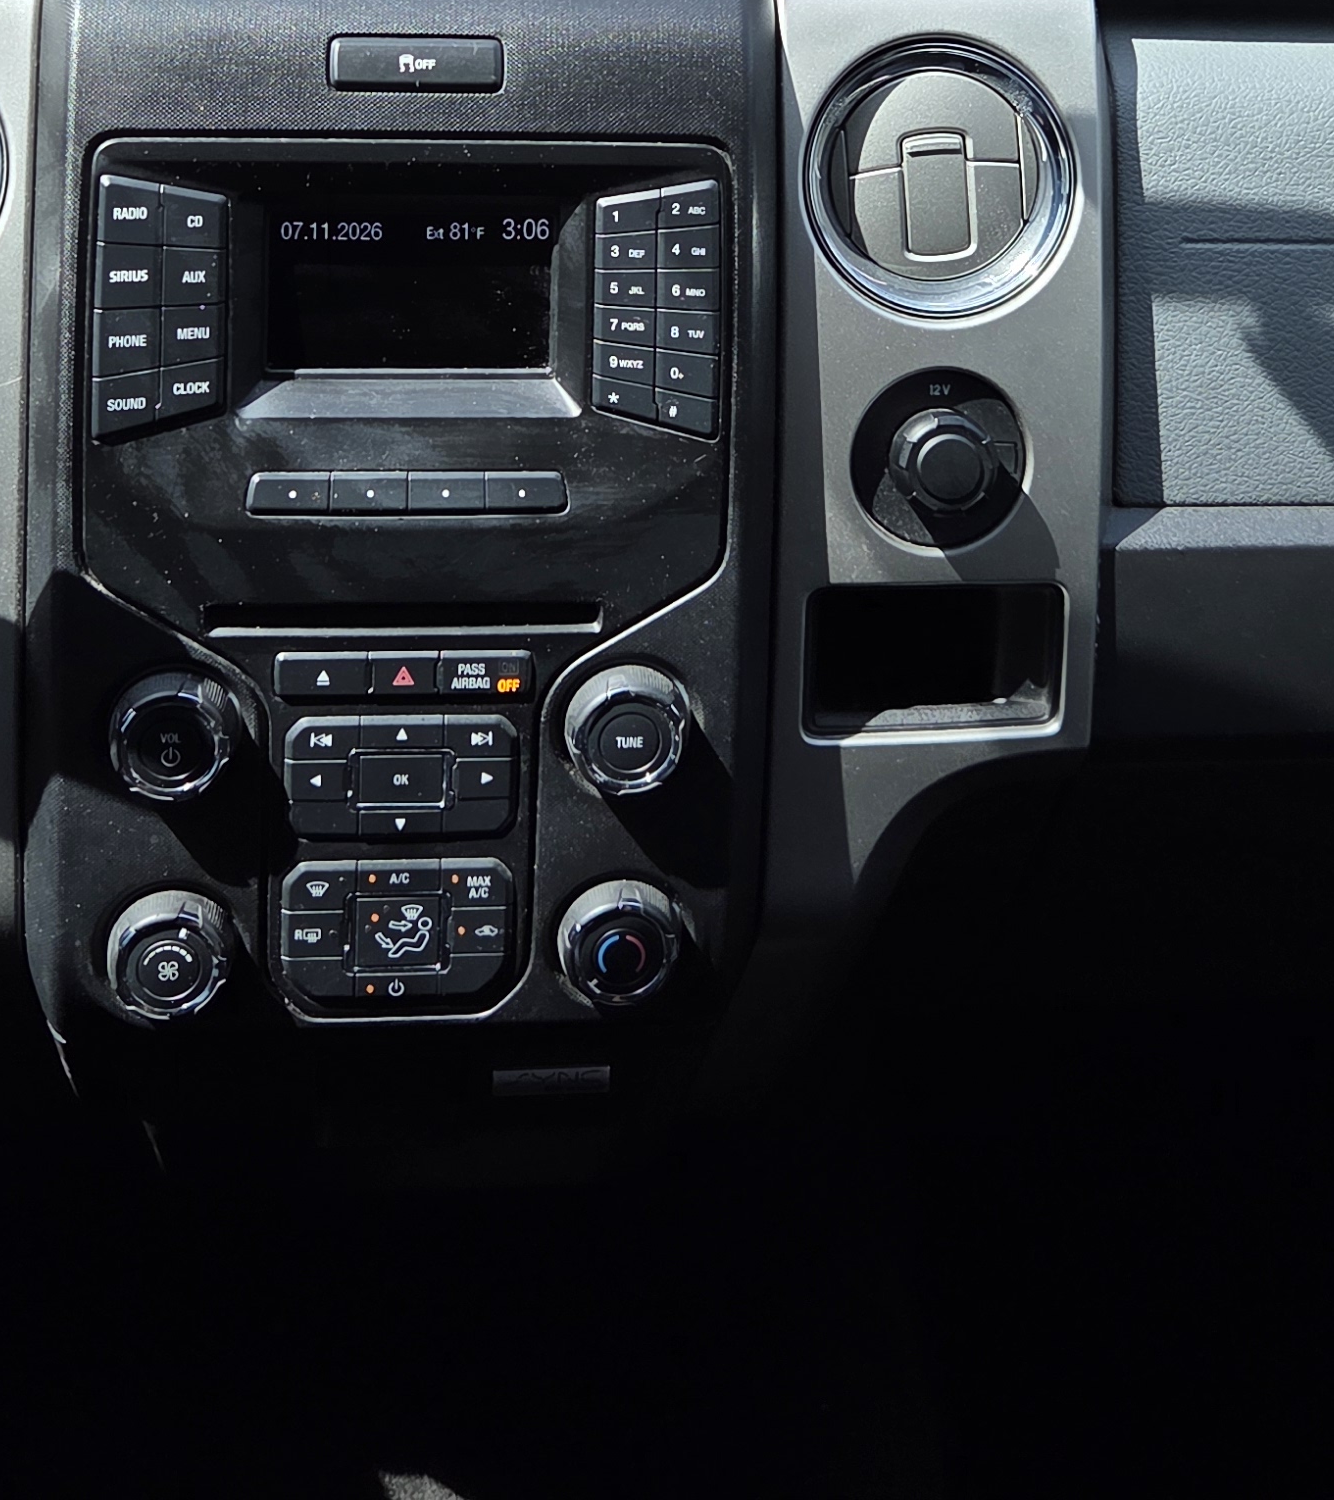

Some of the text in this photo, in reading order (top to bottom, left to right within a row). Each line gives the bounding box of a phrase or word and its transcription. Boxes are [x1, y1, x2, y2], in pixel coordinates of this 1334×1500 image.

[414, 58, 436, 70] OFF
[113, 207, 148, 220] RADIO
[612, 210, 619, 222] 1
[671, 203, 706, 216] 2 ABC
[186, 215, 203, 228] CD
[280, 221, 383, 241] 07.11.2026
[426, 226, 444, 240] Ext
[502, 218, 550, 241] 3:06
[610, 245, 646, 259] 3 DEF
[671, 243, 706, 256] 4 GHI
[109, 269, 149, 283] SIRIUS
[181, 270, 206, 284] AUX
[609, 282, 645, 295] 5 JKL
[671, 284, 706, 297] 6 MNO
[609, 318, 645, 332] 7 PQRS
[177, 327, 210, 341] MENU
[670, 326, 705, 339] 8 TUV
[108, 334, 147, 348] PHONE
[609, 355, 644, 369] 9 WXYZ
[173, 381, 210, 395] CLOCK
[106, 397, 147, 412] SOUND
[457, 661, 516, 675] PASS ON
[451, 677, 520, 693] AIRBAG OFF
[160, 733, 181, 743] VOL
[616, 736, 644, 748] TUNE
[393, 774, 409, 786] OK
[389, 873, 410, 884] A/C
[467, 876, 491, 887] MAX
[469, 888, 489, 899] A/C
[294, 929, 303, 940] R
